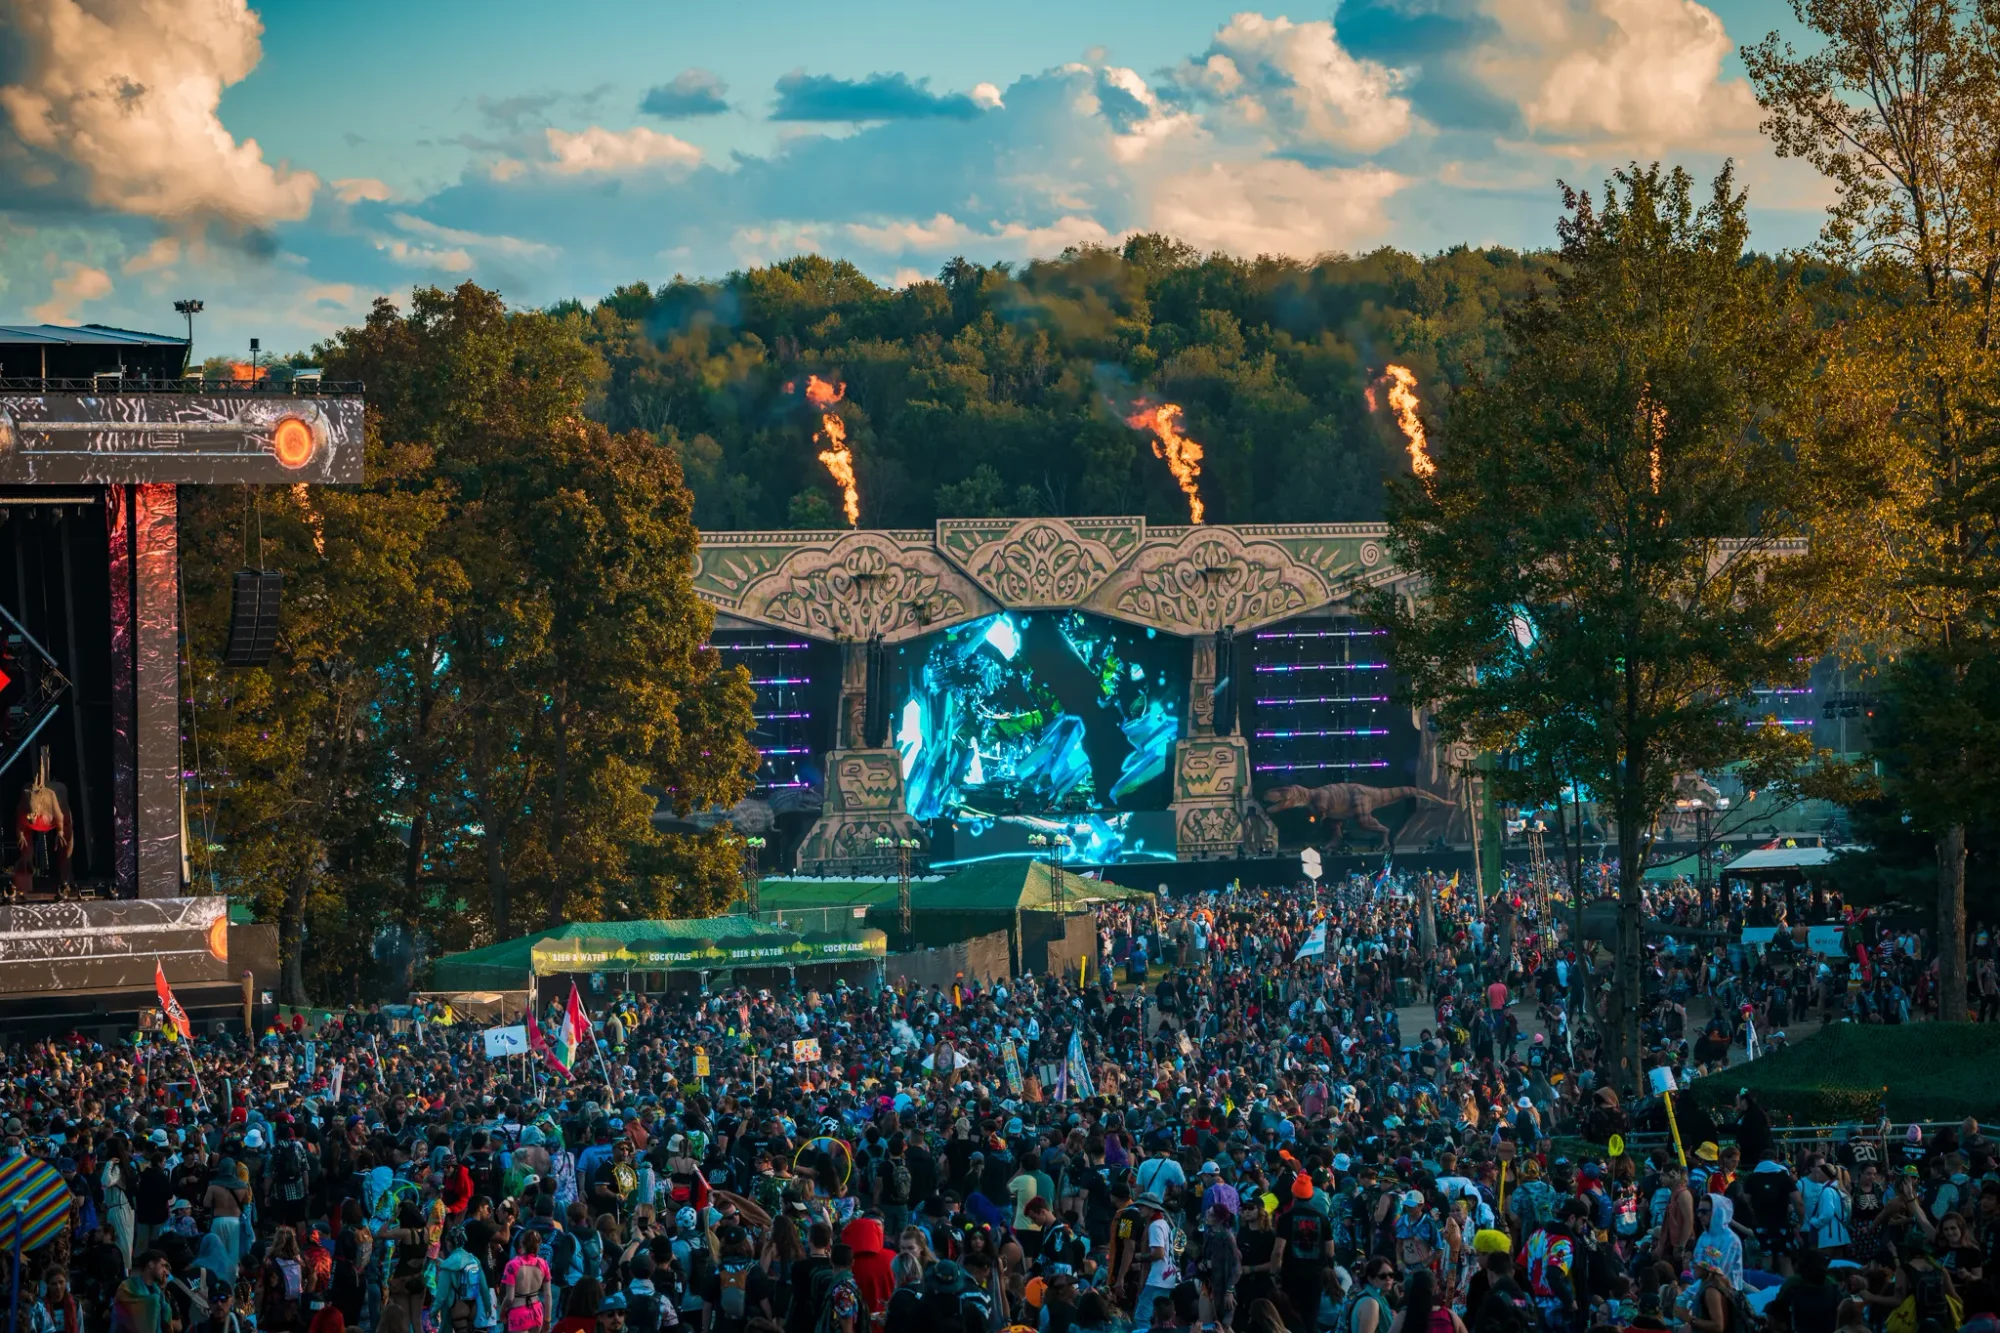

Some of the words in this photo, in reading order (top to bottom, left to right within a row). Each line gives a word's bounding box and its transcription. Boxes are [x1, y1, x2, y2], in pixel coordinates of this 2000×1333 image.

[732, 949, 749, 958] BEER
[750, 949, 757, 957] &
[757, 947, 783, 957] WATER
[823, 942, 864, 953] COCKTAILS
[552, 953, 571, 962] BEER
[572, 953, 578, 962] &
[580, 953, 607, 962] WATER
[649, 952, 692, 961] COCKTAILS
[1852, 1146, 1879, 1163] 20
